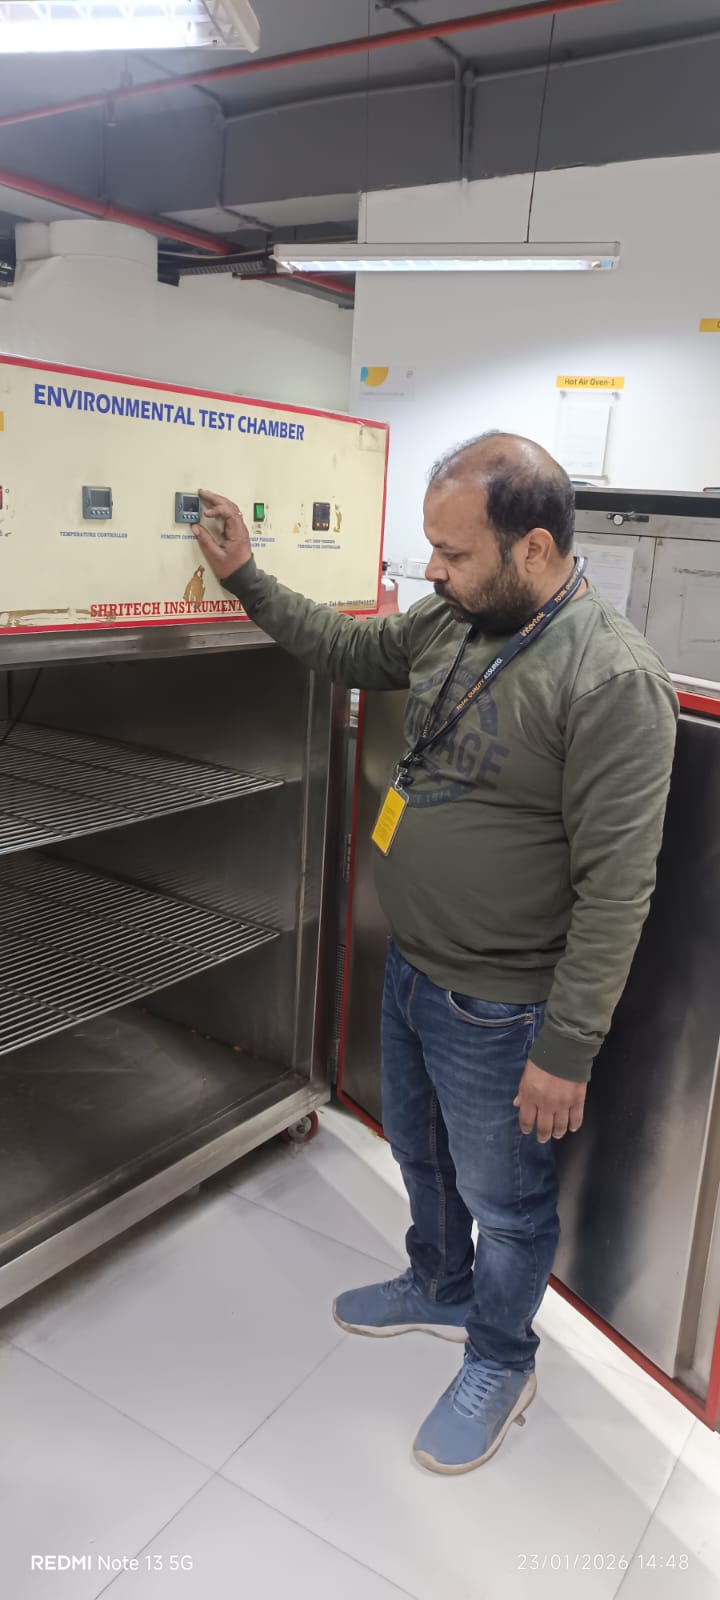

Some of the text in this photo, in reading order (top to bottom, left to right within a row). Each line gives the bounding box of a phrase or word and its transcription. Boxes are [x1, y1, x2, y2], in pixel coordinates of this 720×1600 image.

[564, 377, 577, 385] Hot
[578, 377, 588, 385] Air
[34, 383, 305, 441] ENVIRONMENTAL TEST CHAMBER
[90, 601, 161, 618] SHRITECH
